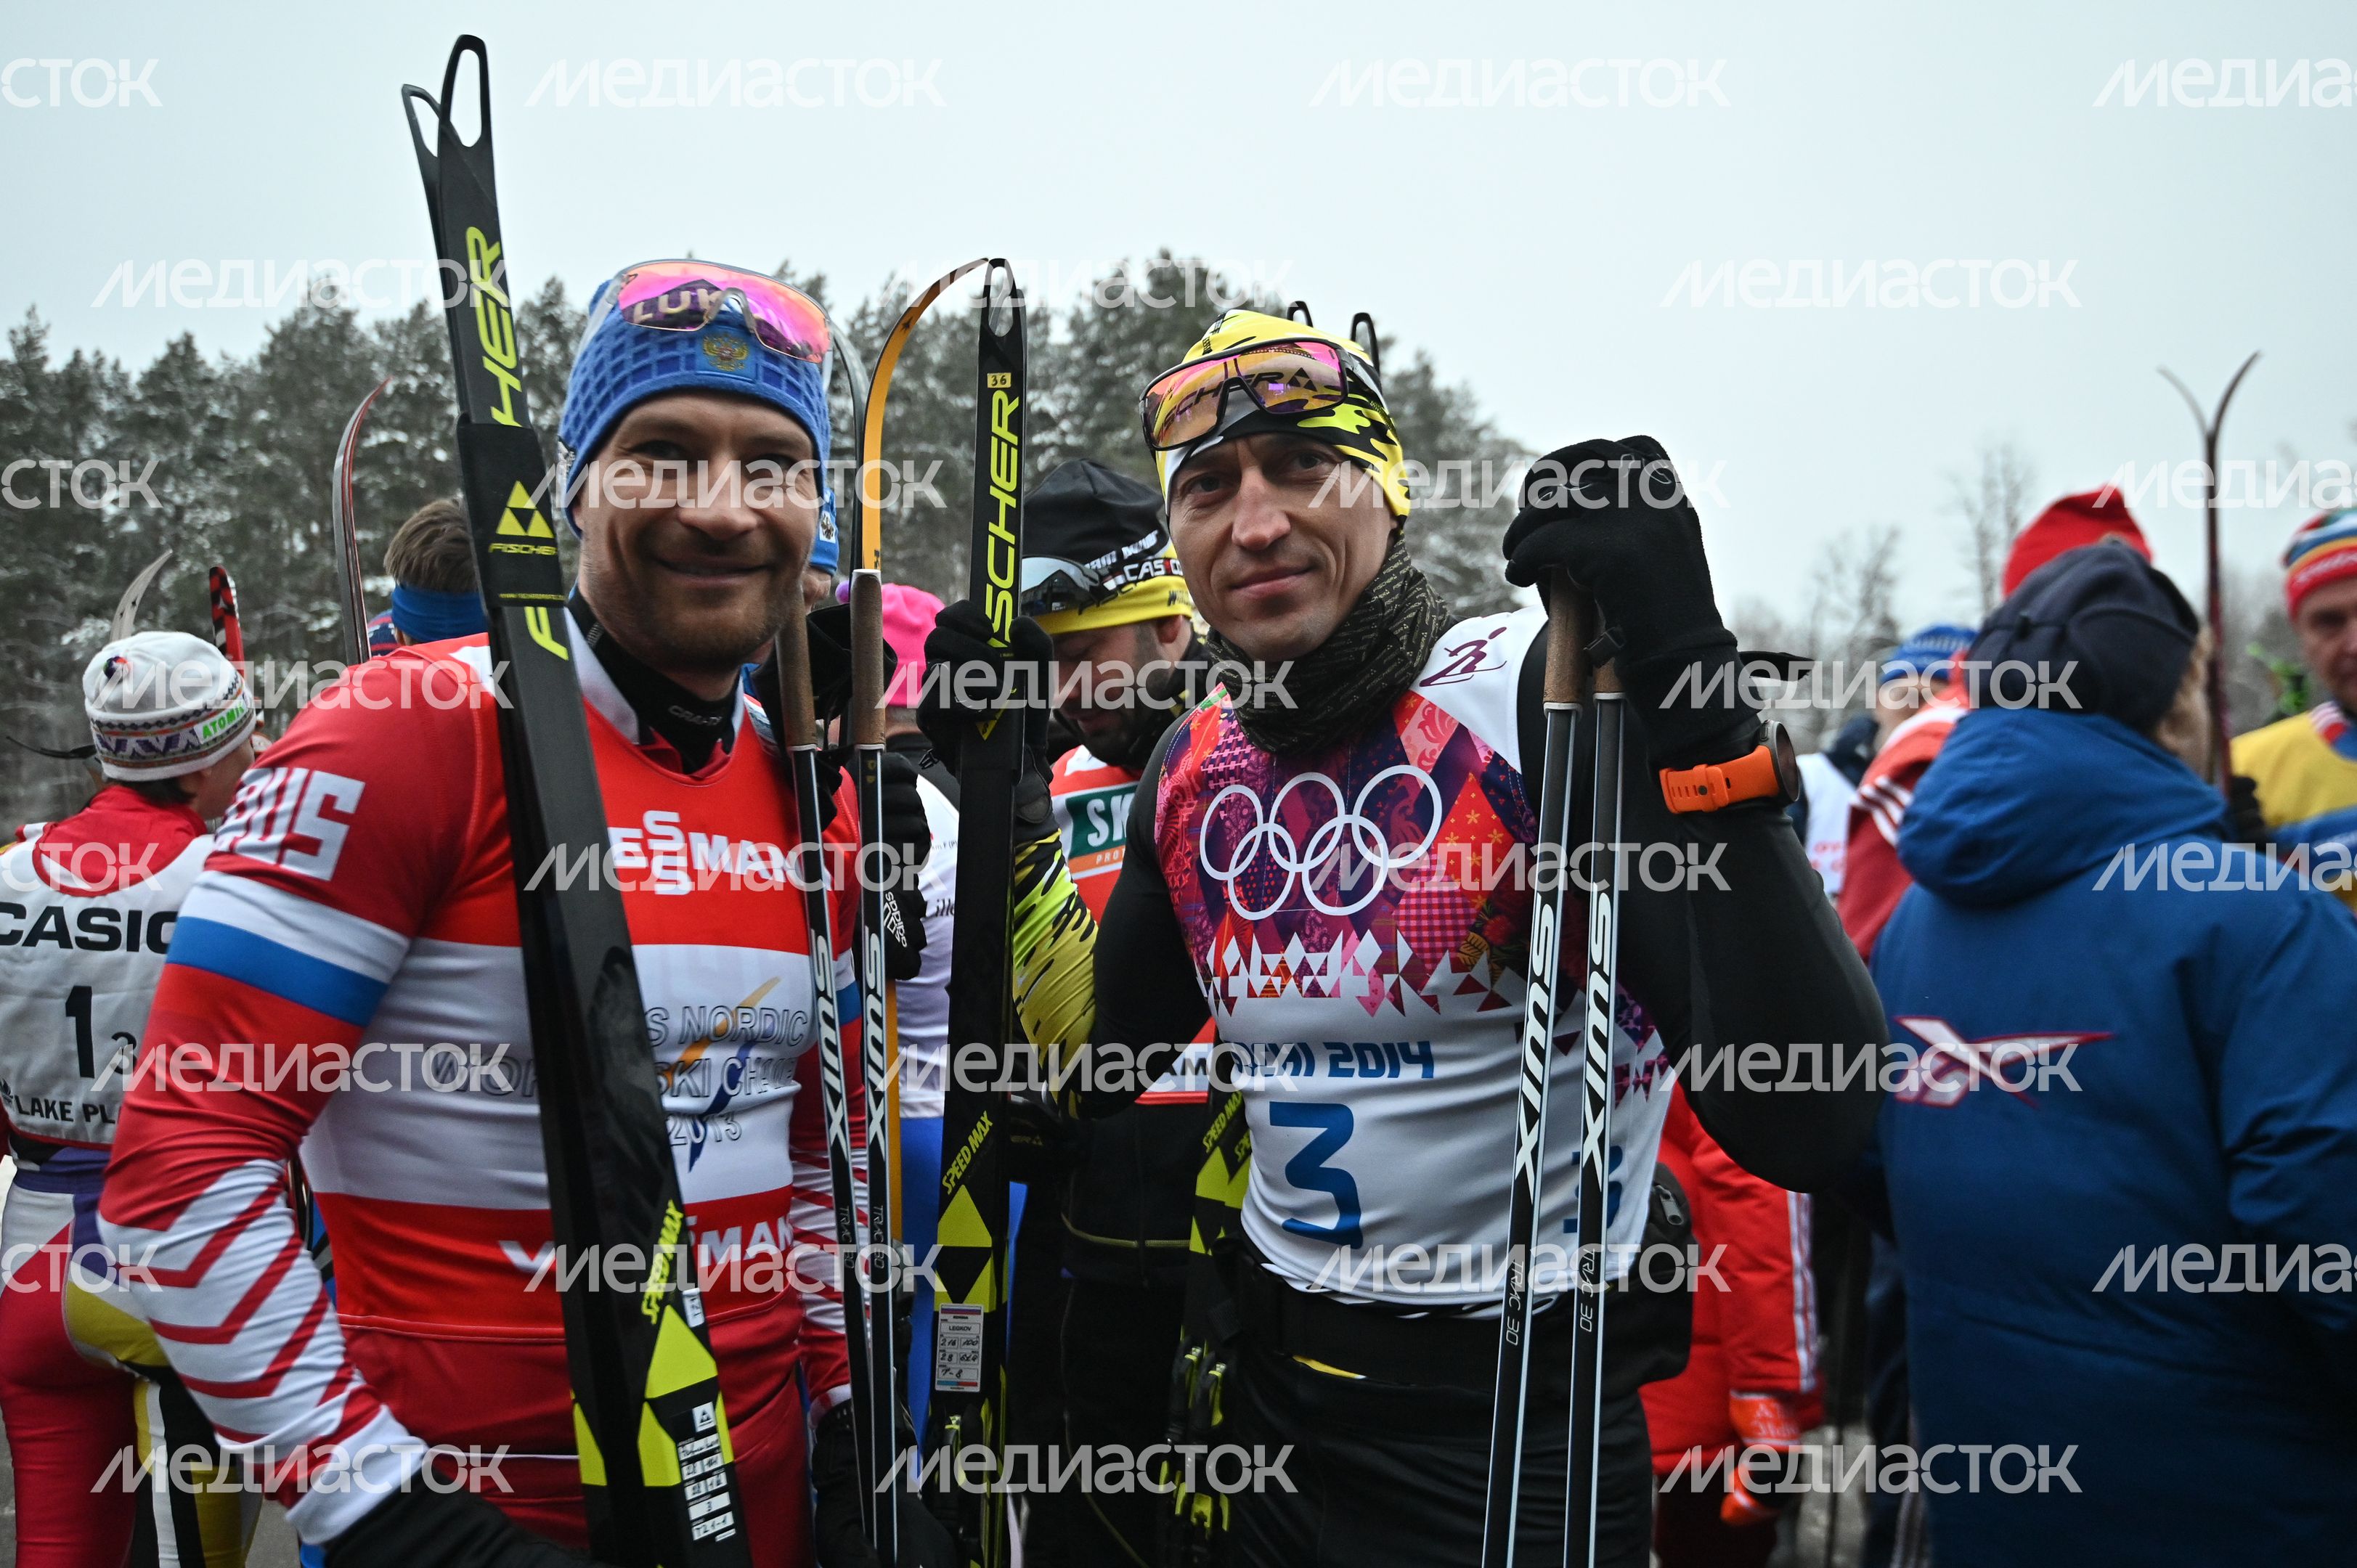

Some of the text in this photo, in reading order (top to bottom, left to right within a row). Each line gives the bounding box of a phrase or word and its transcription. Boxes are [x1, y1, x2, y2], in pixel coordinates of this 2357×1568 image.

[991, 375, 1007, 387] 36
[214, 767, 366, 881] RUS
[0, 902, 179, 955] CASIO
[679, 1005, 808, 1047] NORDIC
[1322, 1041, 1434, 1079] 2014
[15, 1095, 122, 1125] LAKE PL
[667, 1111, 744, 1147] 2013
[1269, 1101, 1364, 1250] 3
